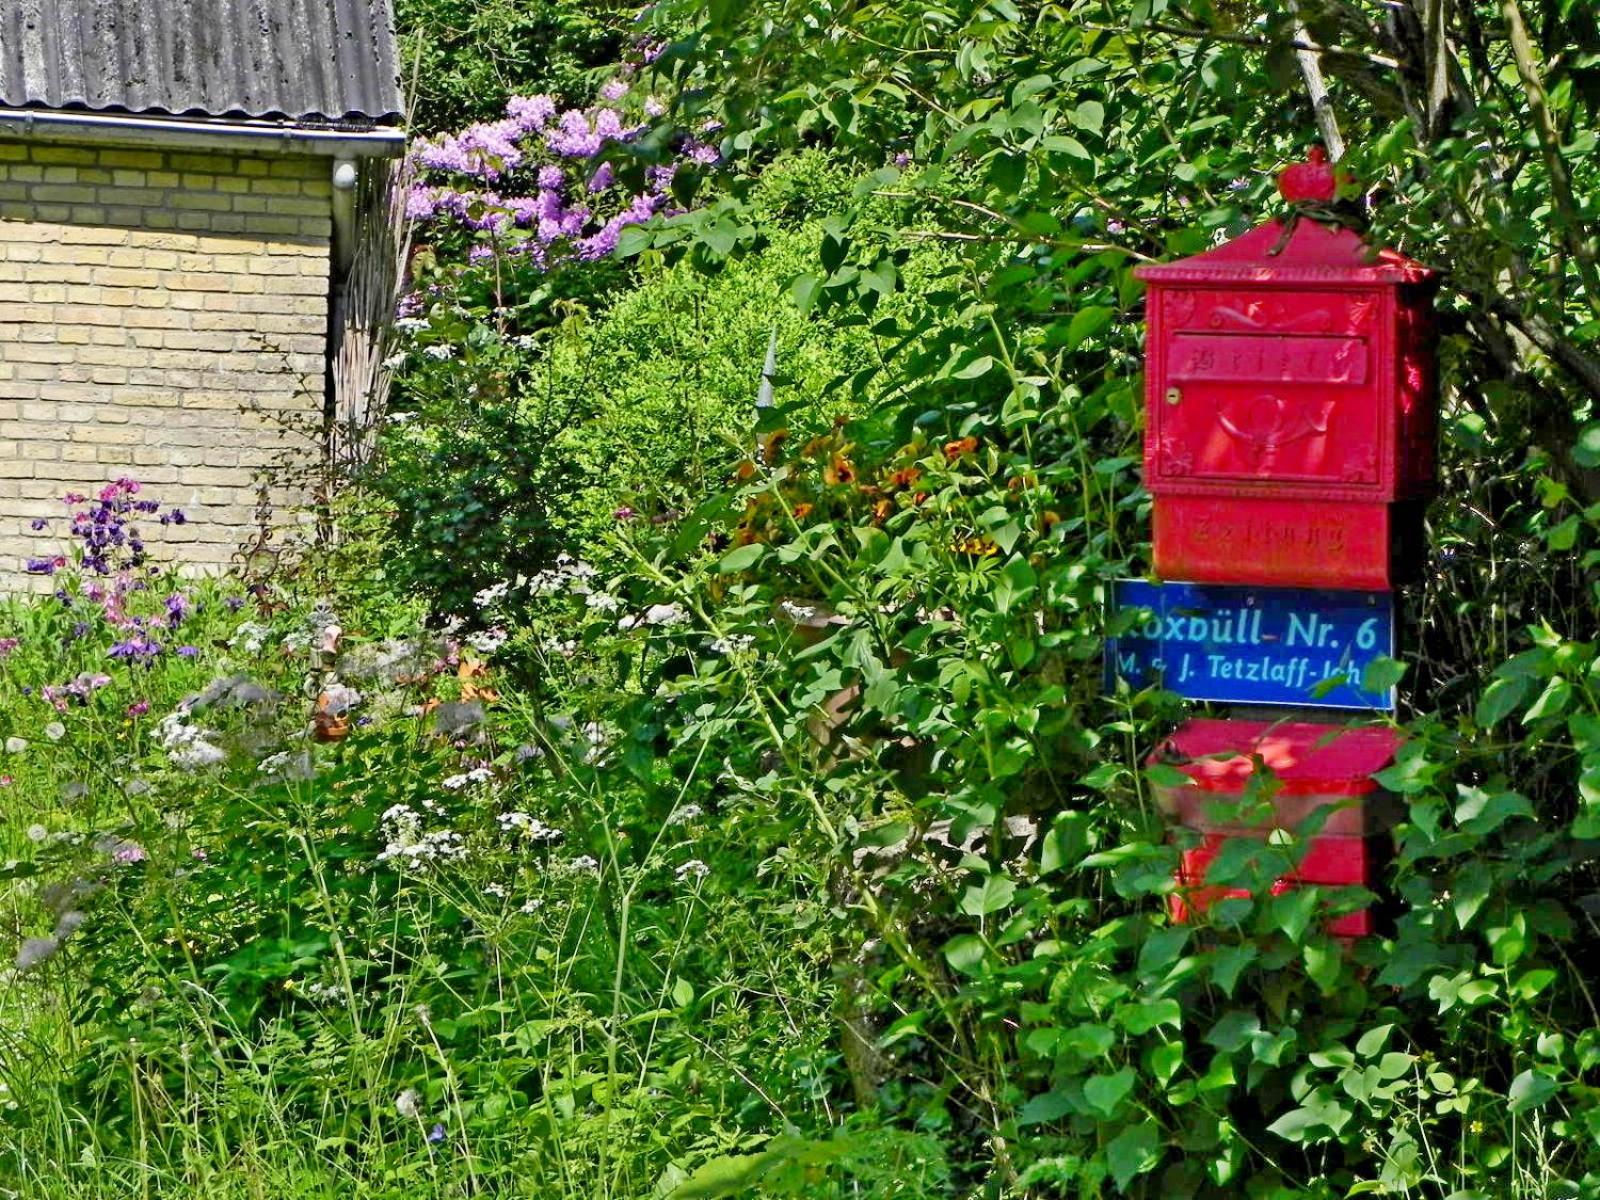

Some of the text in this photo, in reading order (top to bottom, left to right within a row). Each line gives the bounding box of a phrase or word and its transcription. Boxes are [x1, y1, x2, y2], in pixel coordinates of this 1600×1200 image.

[1117, 608, 1379, 651] oxbüll Nr. 6
[1118, 651, 1141, 674] M.
[1177, 652, 1195, 683] J.
